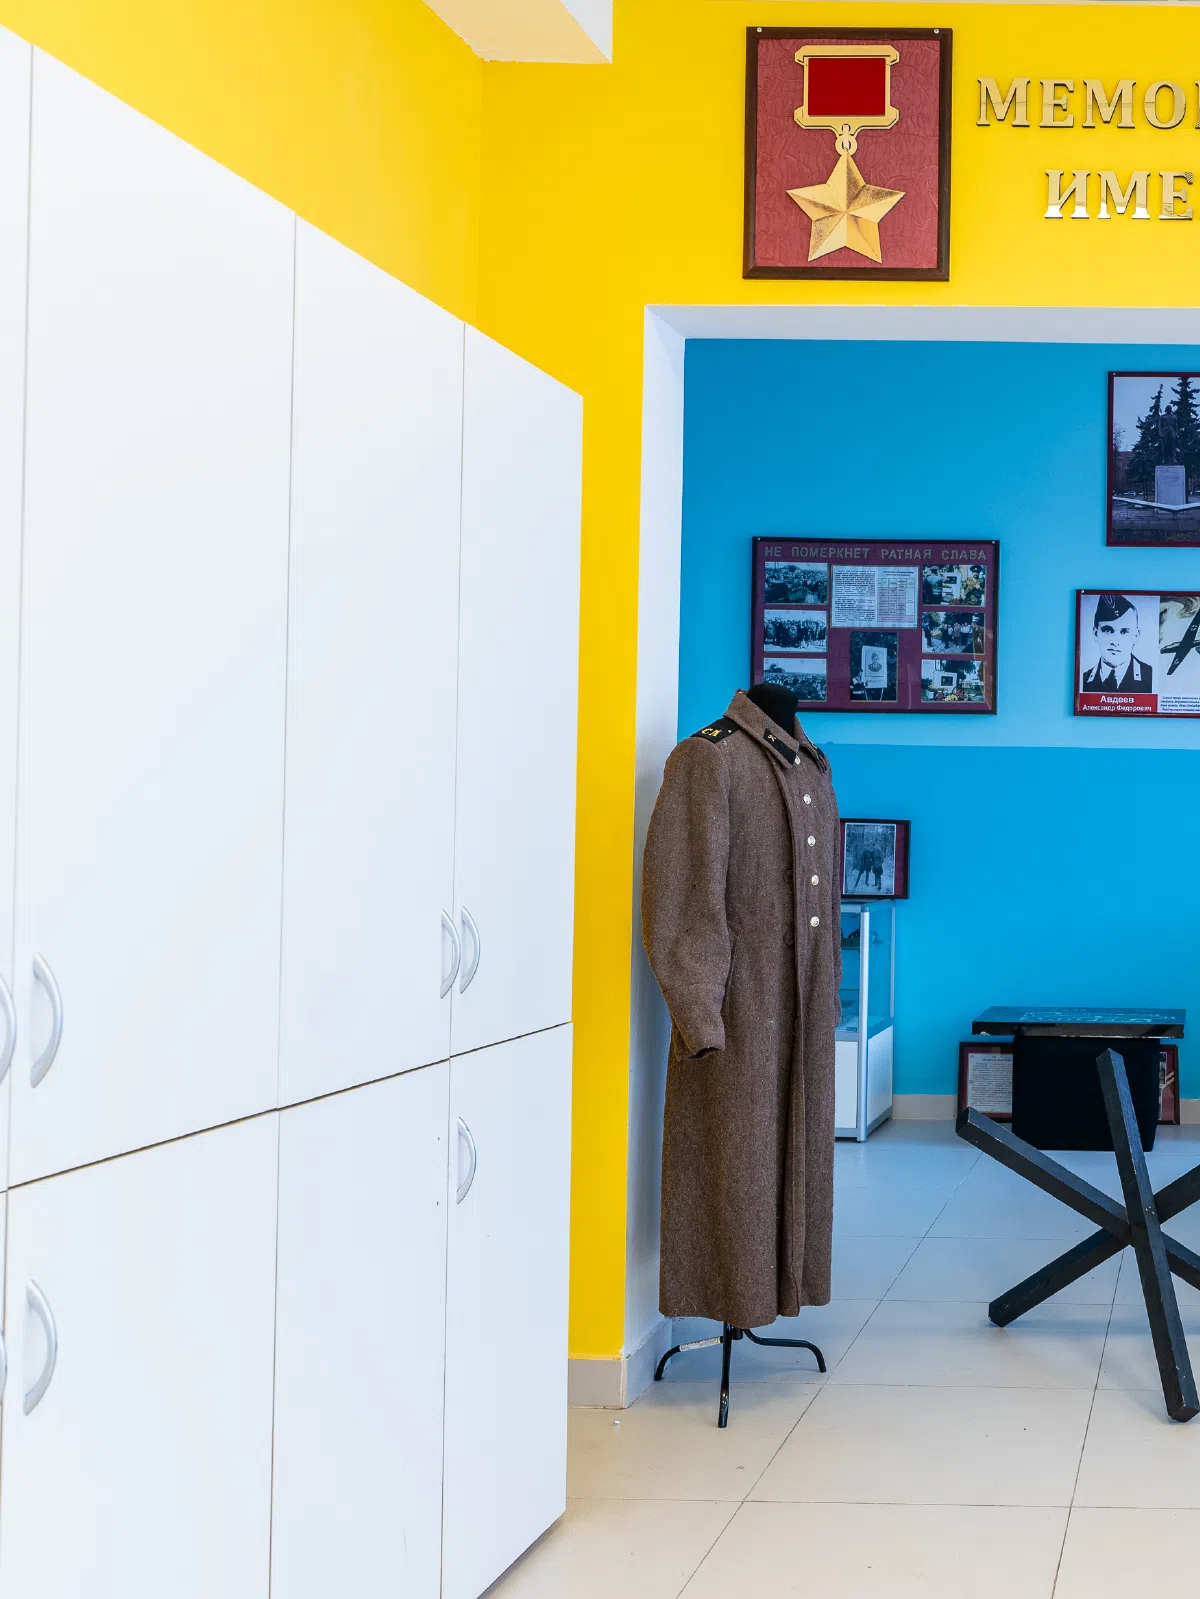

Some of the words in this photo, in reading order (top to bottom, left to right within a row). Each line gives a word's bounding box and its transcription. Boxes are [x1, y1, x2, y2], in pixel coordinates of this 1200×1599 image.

[765, 546, 782, 557] НЕ
[791, 546, 870, 559] ПОМЕРКНЕТ
[881, 548, 932, 560] РАТНАЯ
[941, 549, 987, 560] СЛАВА
[1100, 695, 1135, 704] Авдеев
